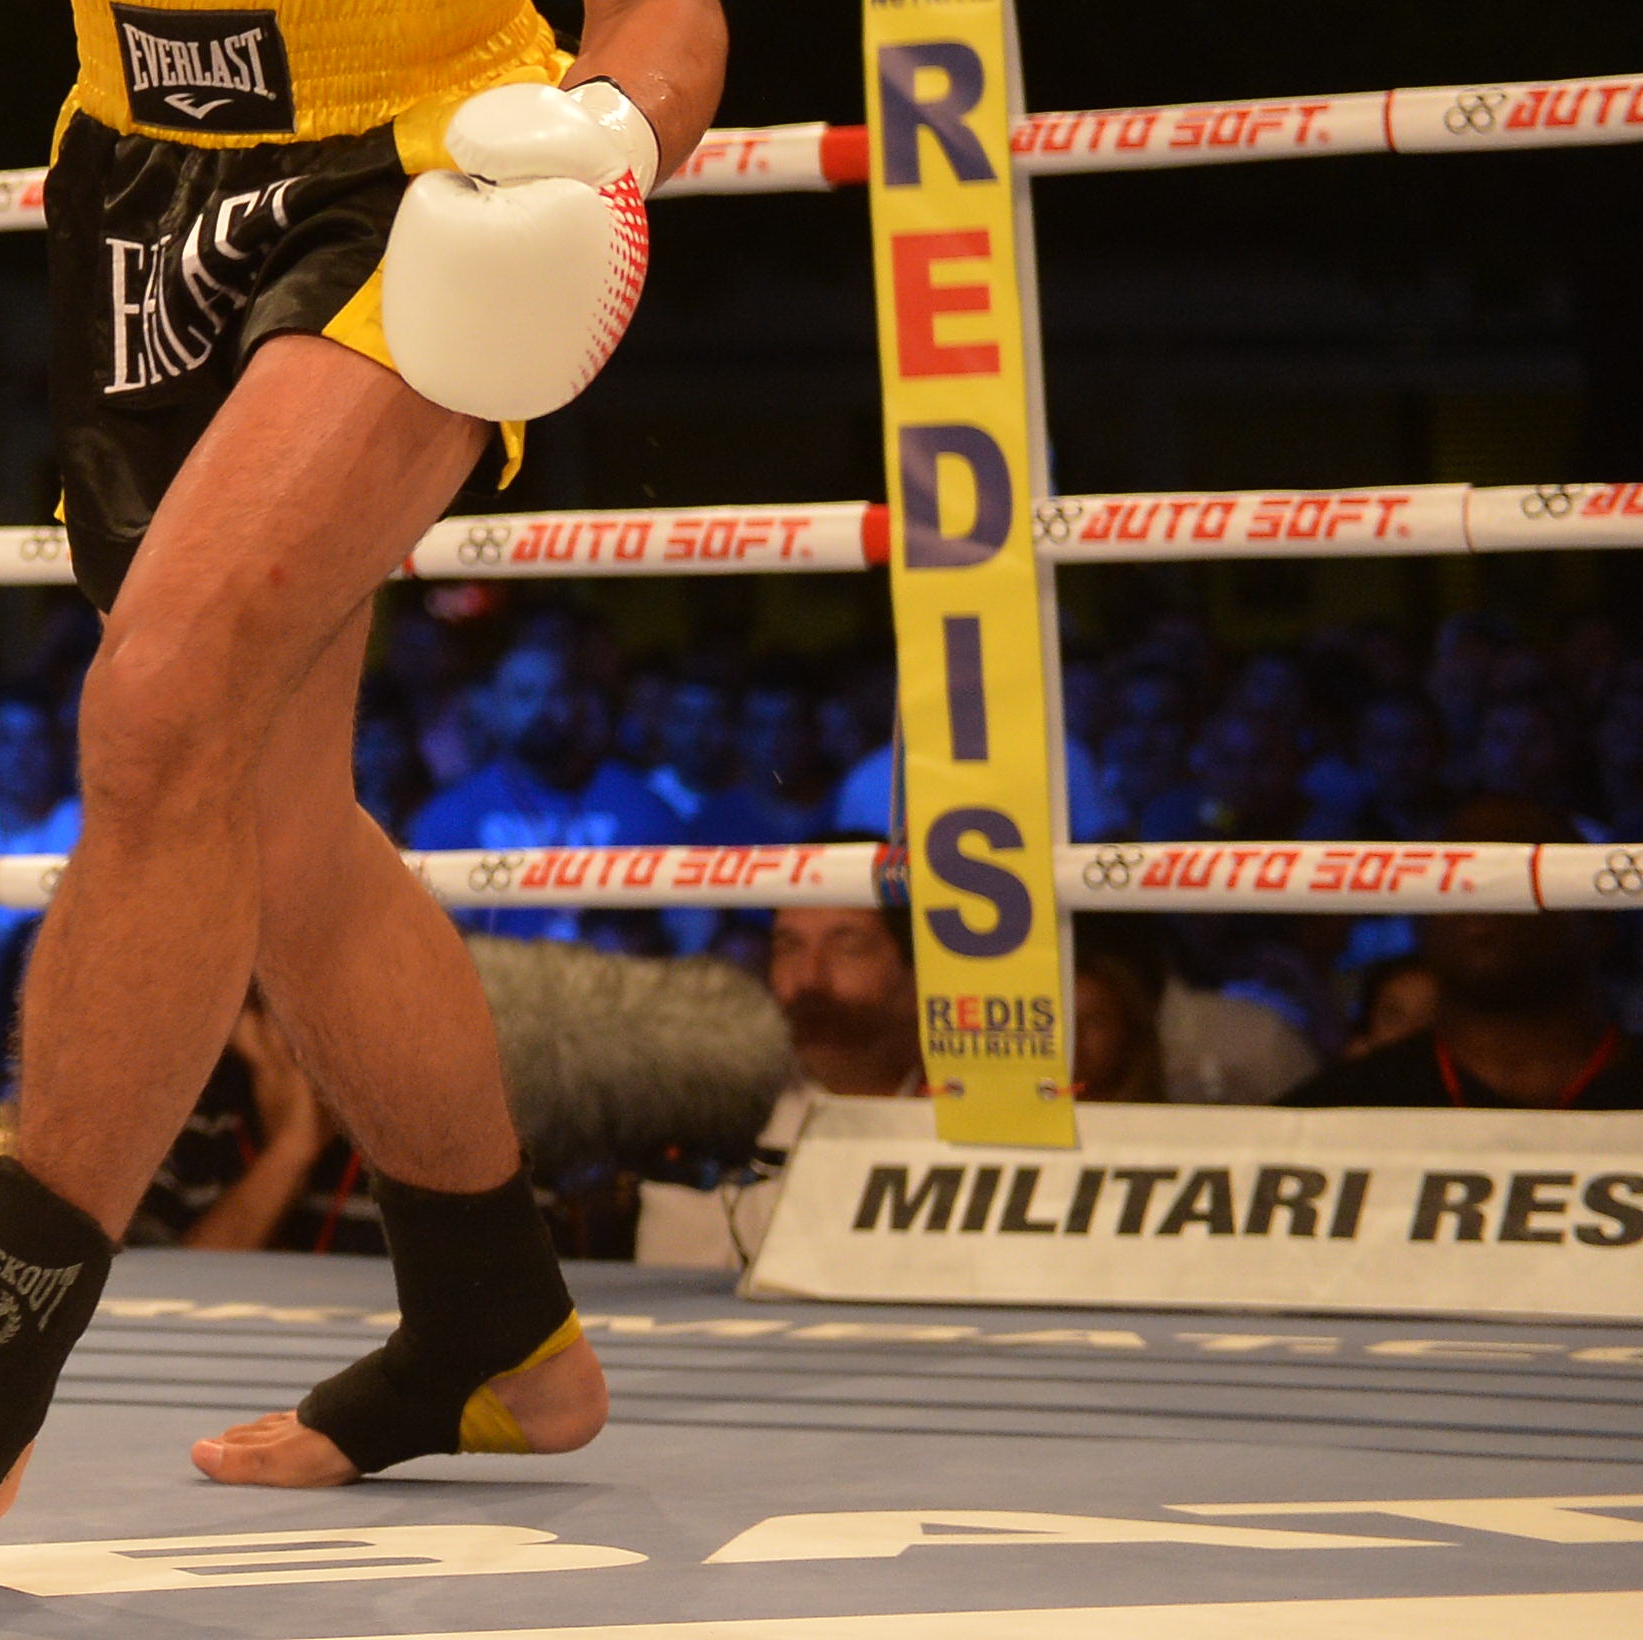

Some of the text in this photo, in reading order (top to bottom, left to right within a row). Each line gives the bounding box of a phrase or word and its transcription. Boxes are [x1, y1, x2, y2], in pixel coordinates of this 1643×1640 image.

[122, 22, 269, 97] EVERLAST
[1008, 110, 1161, 157] AUTO
[876, 40, 1033, 960] REDIS
[1080, 499, 1238, 542] AUTO
[510, 520, 655, 563] AUTO
[519, 848, 666, 890] AUTO
[1141, 849, 1302, 891] AUTO
[926, 994, 1055, 1034] REDIS
[851, 1164, 1370, 1242] MILITARI
